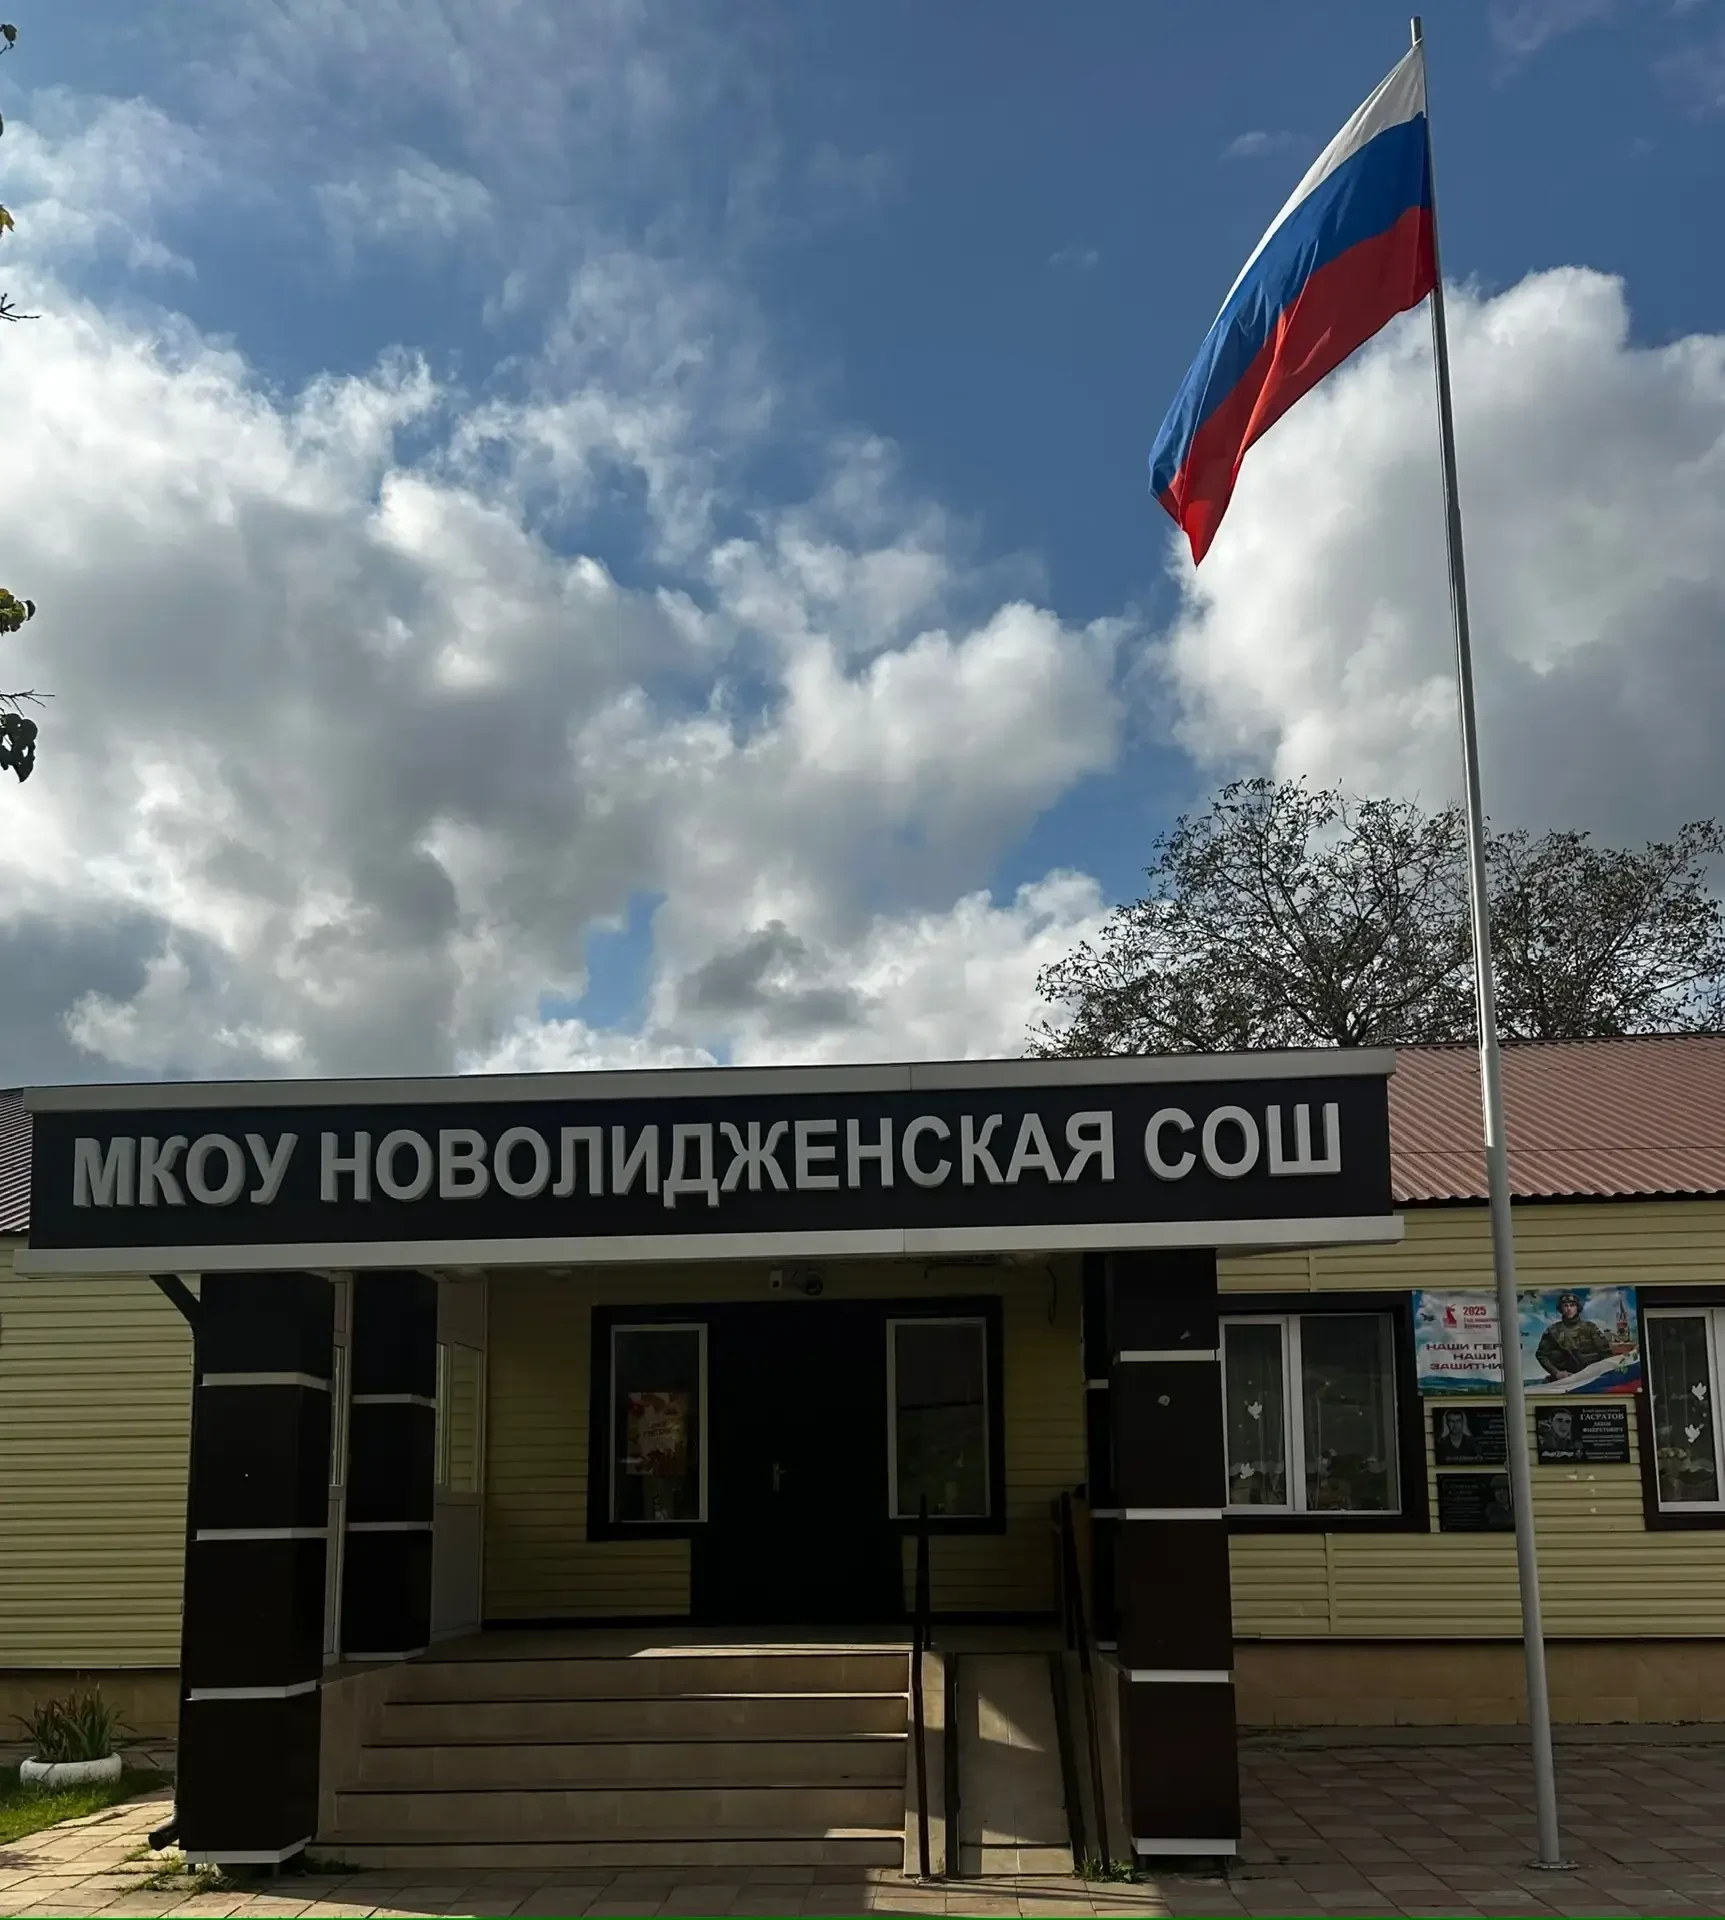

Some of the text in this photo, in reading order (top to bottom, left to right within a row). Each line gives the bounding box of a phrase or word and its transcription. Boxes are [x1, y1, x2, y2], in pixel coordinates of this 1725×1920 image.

[72, 1102, 1342, 1209] МКОУ НОВОЛИДЖЕНСКАЯ СОШ
[1462, 1305, 1487, 1316] 2025
[1426, 1343, 1469, 1351] НАШИ
[1453, 1352, 1497, 1361] НАШИ
[1580, 1412, 1625, 1421] ГАСРАТОВ
